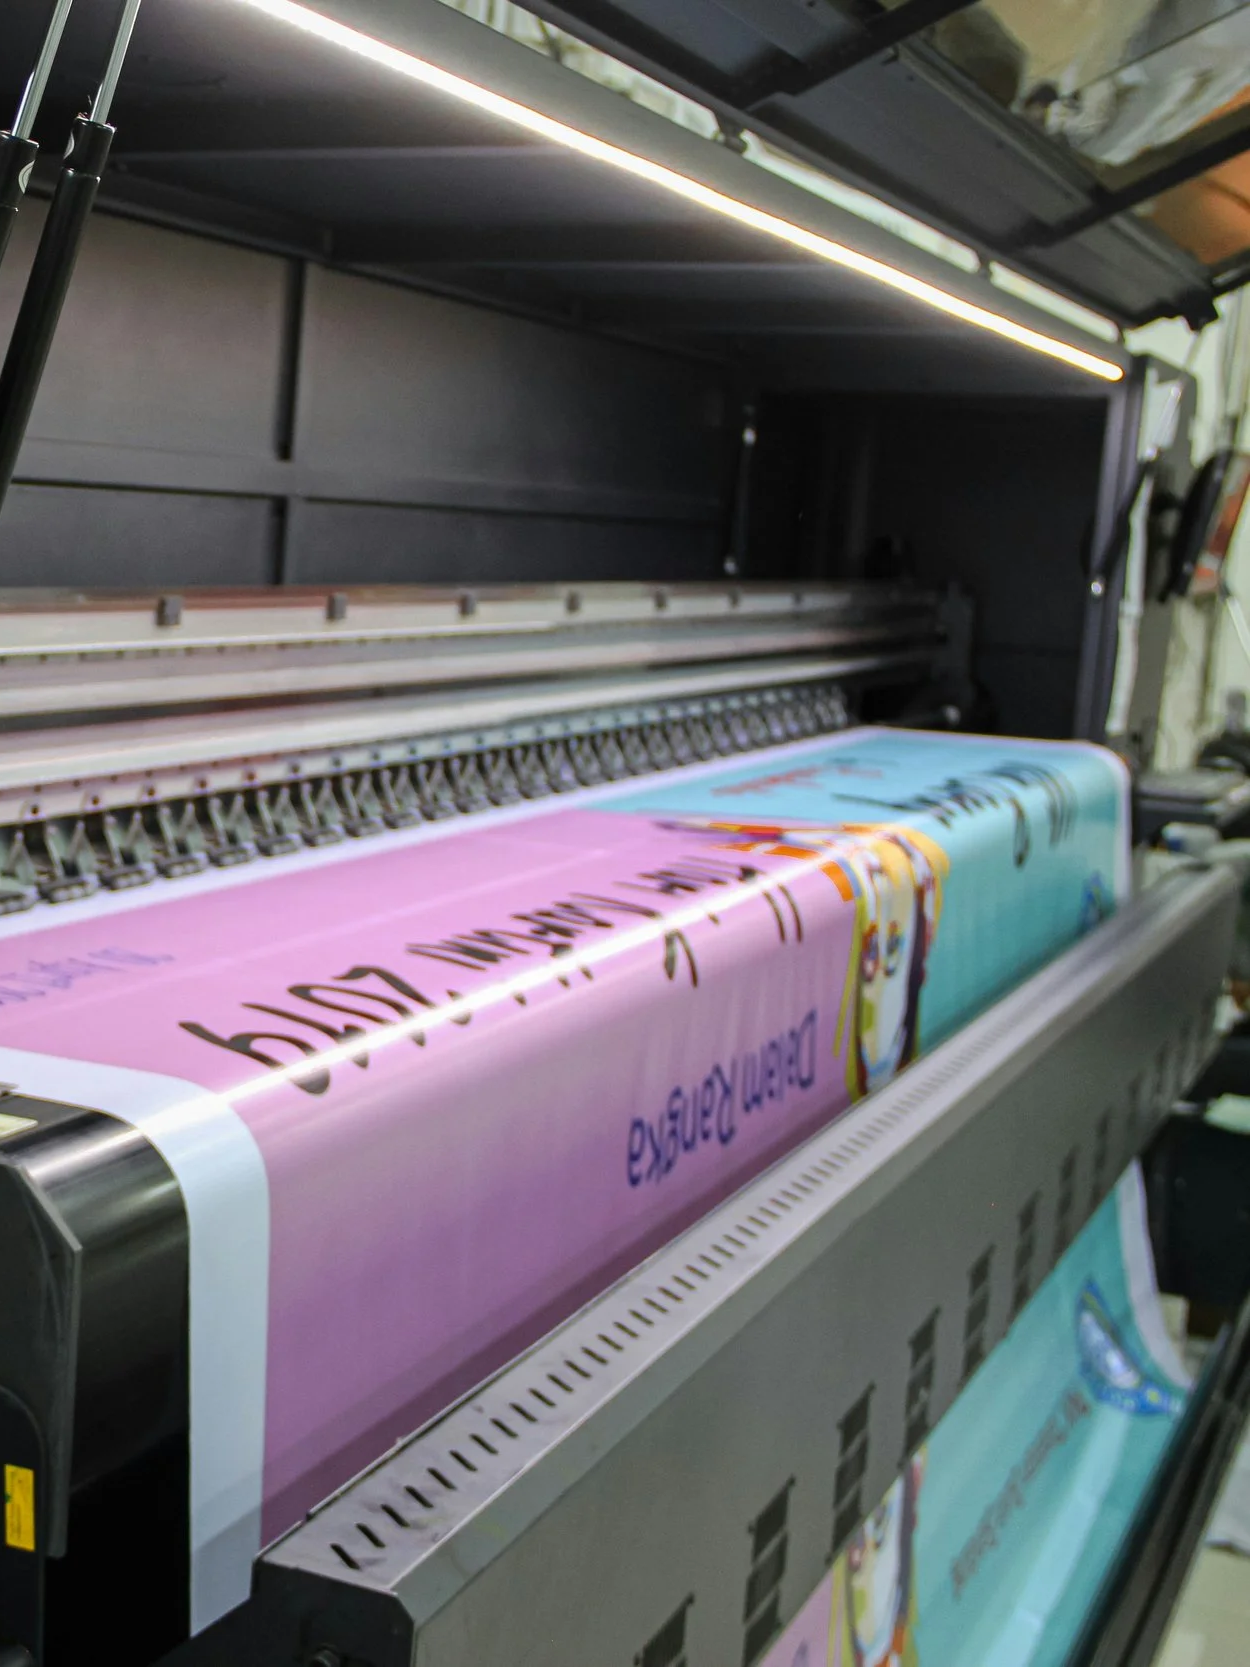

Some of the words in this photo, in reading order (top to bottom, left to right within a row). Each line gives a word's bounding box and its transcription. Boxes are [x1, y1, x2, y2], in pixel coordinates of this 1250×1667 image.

[178, 965, 474, 1098] 2019
[742, 1009, 817, 1113] Dalam
[627, 1058, 738, 1188] Rangka
